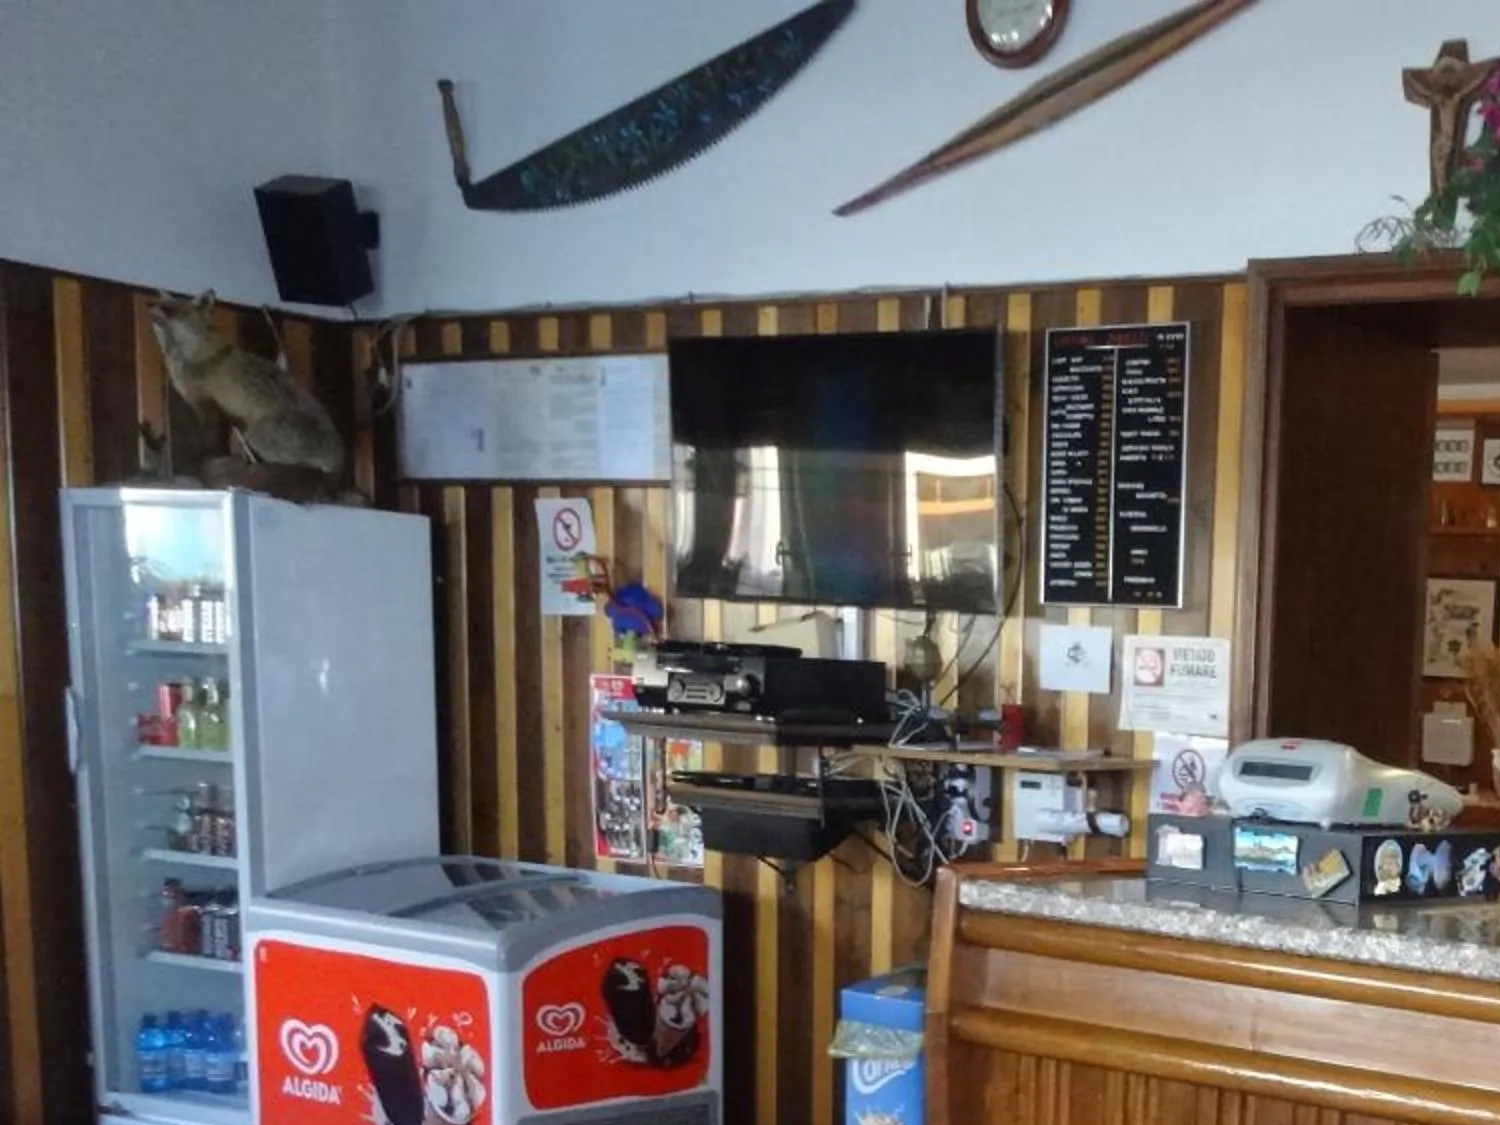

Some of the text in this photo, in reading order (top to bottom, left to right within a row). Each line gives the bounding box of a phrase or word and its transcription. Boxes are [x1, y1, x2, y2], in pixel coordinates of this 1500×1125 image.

[1172, 647, 1216, 662] VIETATO
[1169, 663, 1217, 679] FUMARE
[536, 1037, 587, 1053] ALGIDA
[282, 1075, 341, 1105] ALGIDA
